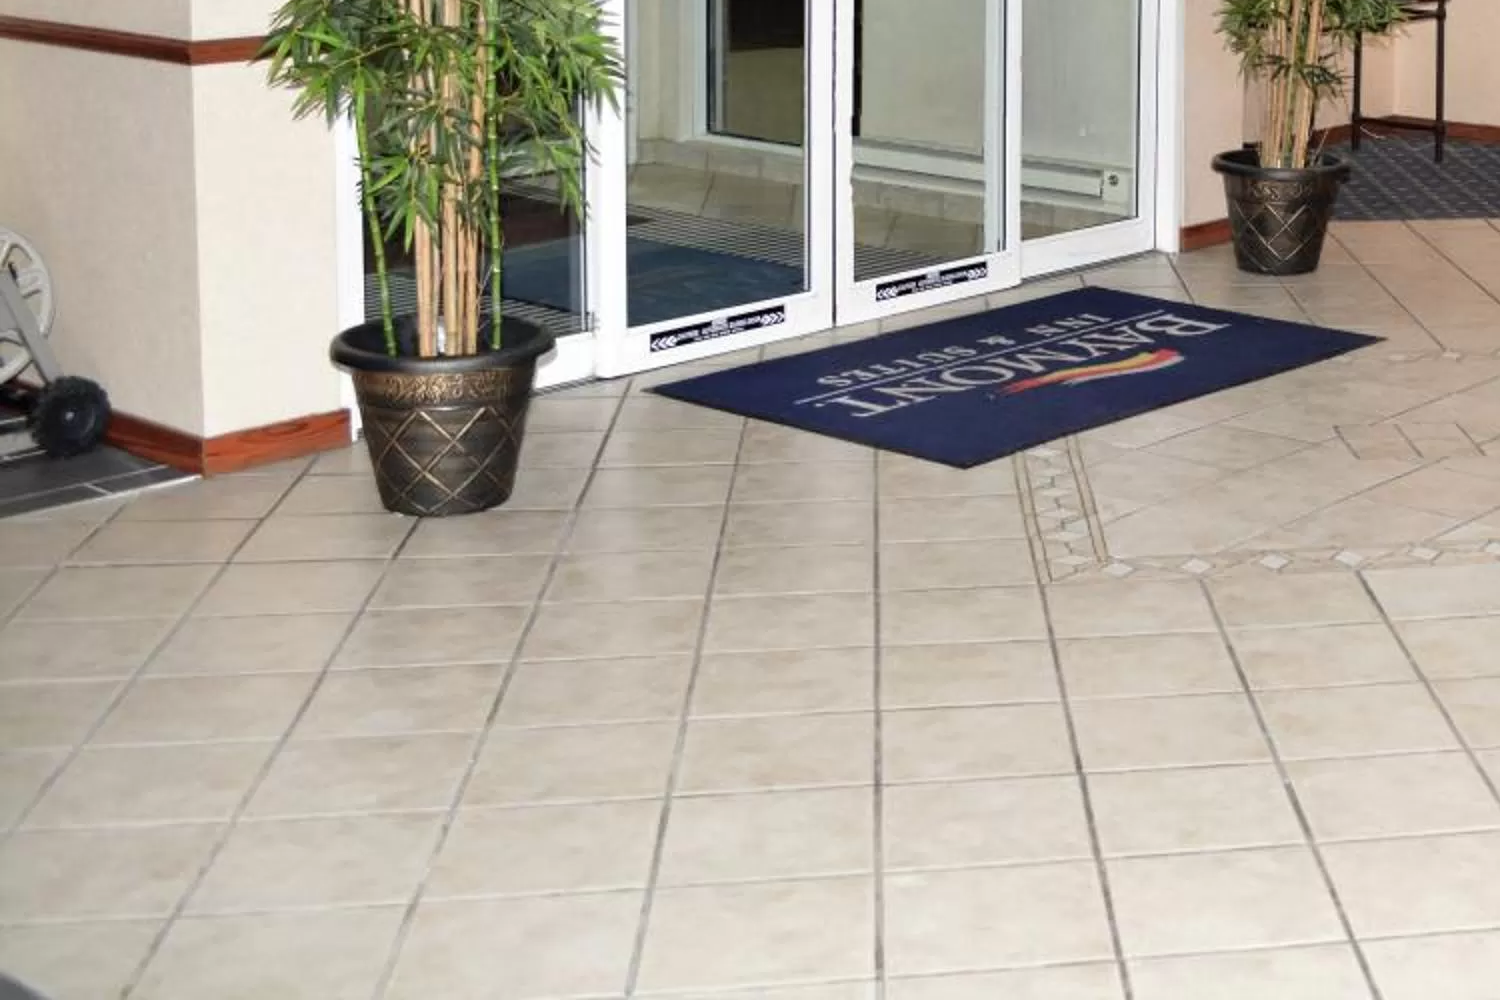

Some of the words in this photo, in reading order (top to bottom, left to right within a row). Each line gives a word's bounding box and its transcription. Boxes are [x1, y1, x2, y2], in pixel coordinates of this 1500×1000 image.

[976, 334, 1016, 346] &
[1025, 313, 1111, 337] INN
[816, 345, 977, 387] SUITES
[828, 314, 1232, 417] BAYMONT
